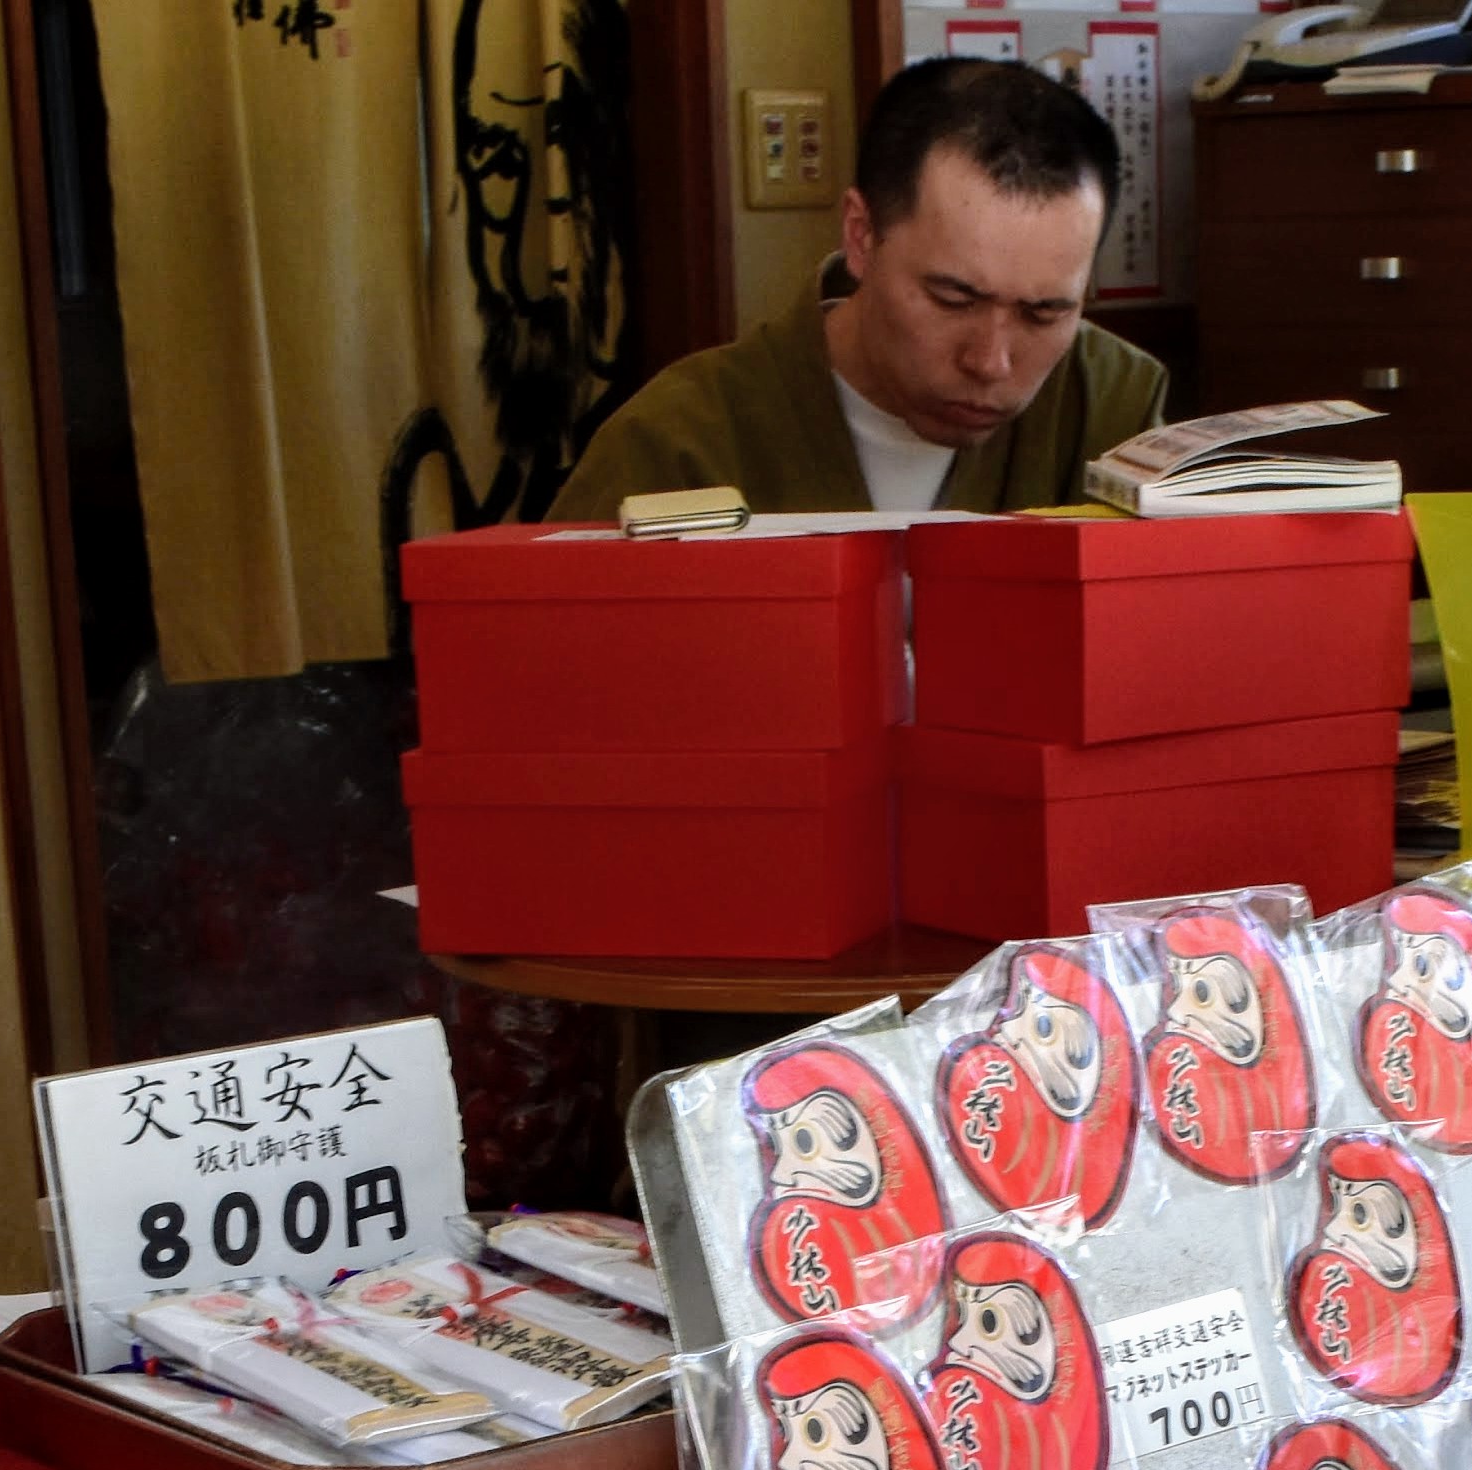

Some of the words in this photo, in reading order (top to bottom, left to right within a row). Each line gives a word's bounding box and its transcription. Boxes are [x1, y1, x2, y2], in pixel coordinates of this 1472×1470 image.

[119, 1042, 394, 1147] 交通安全
[194, 1124, 349, 1177] 板札御守護
[138, 1163, 408, 1281] 800円
[1148, 1382, 1266, 1446] 700円
